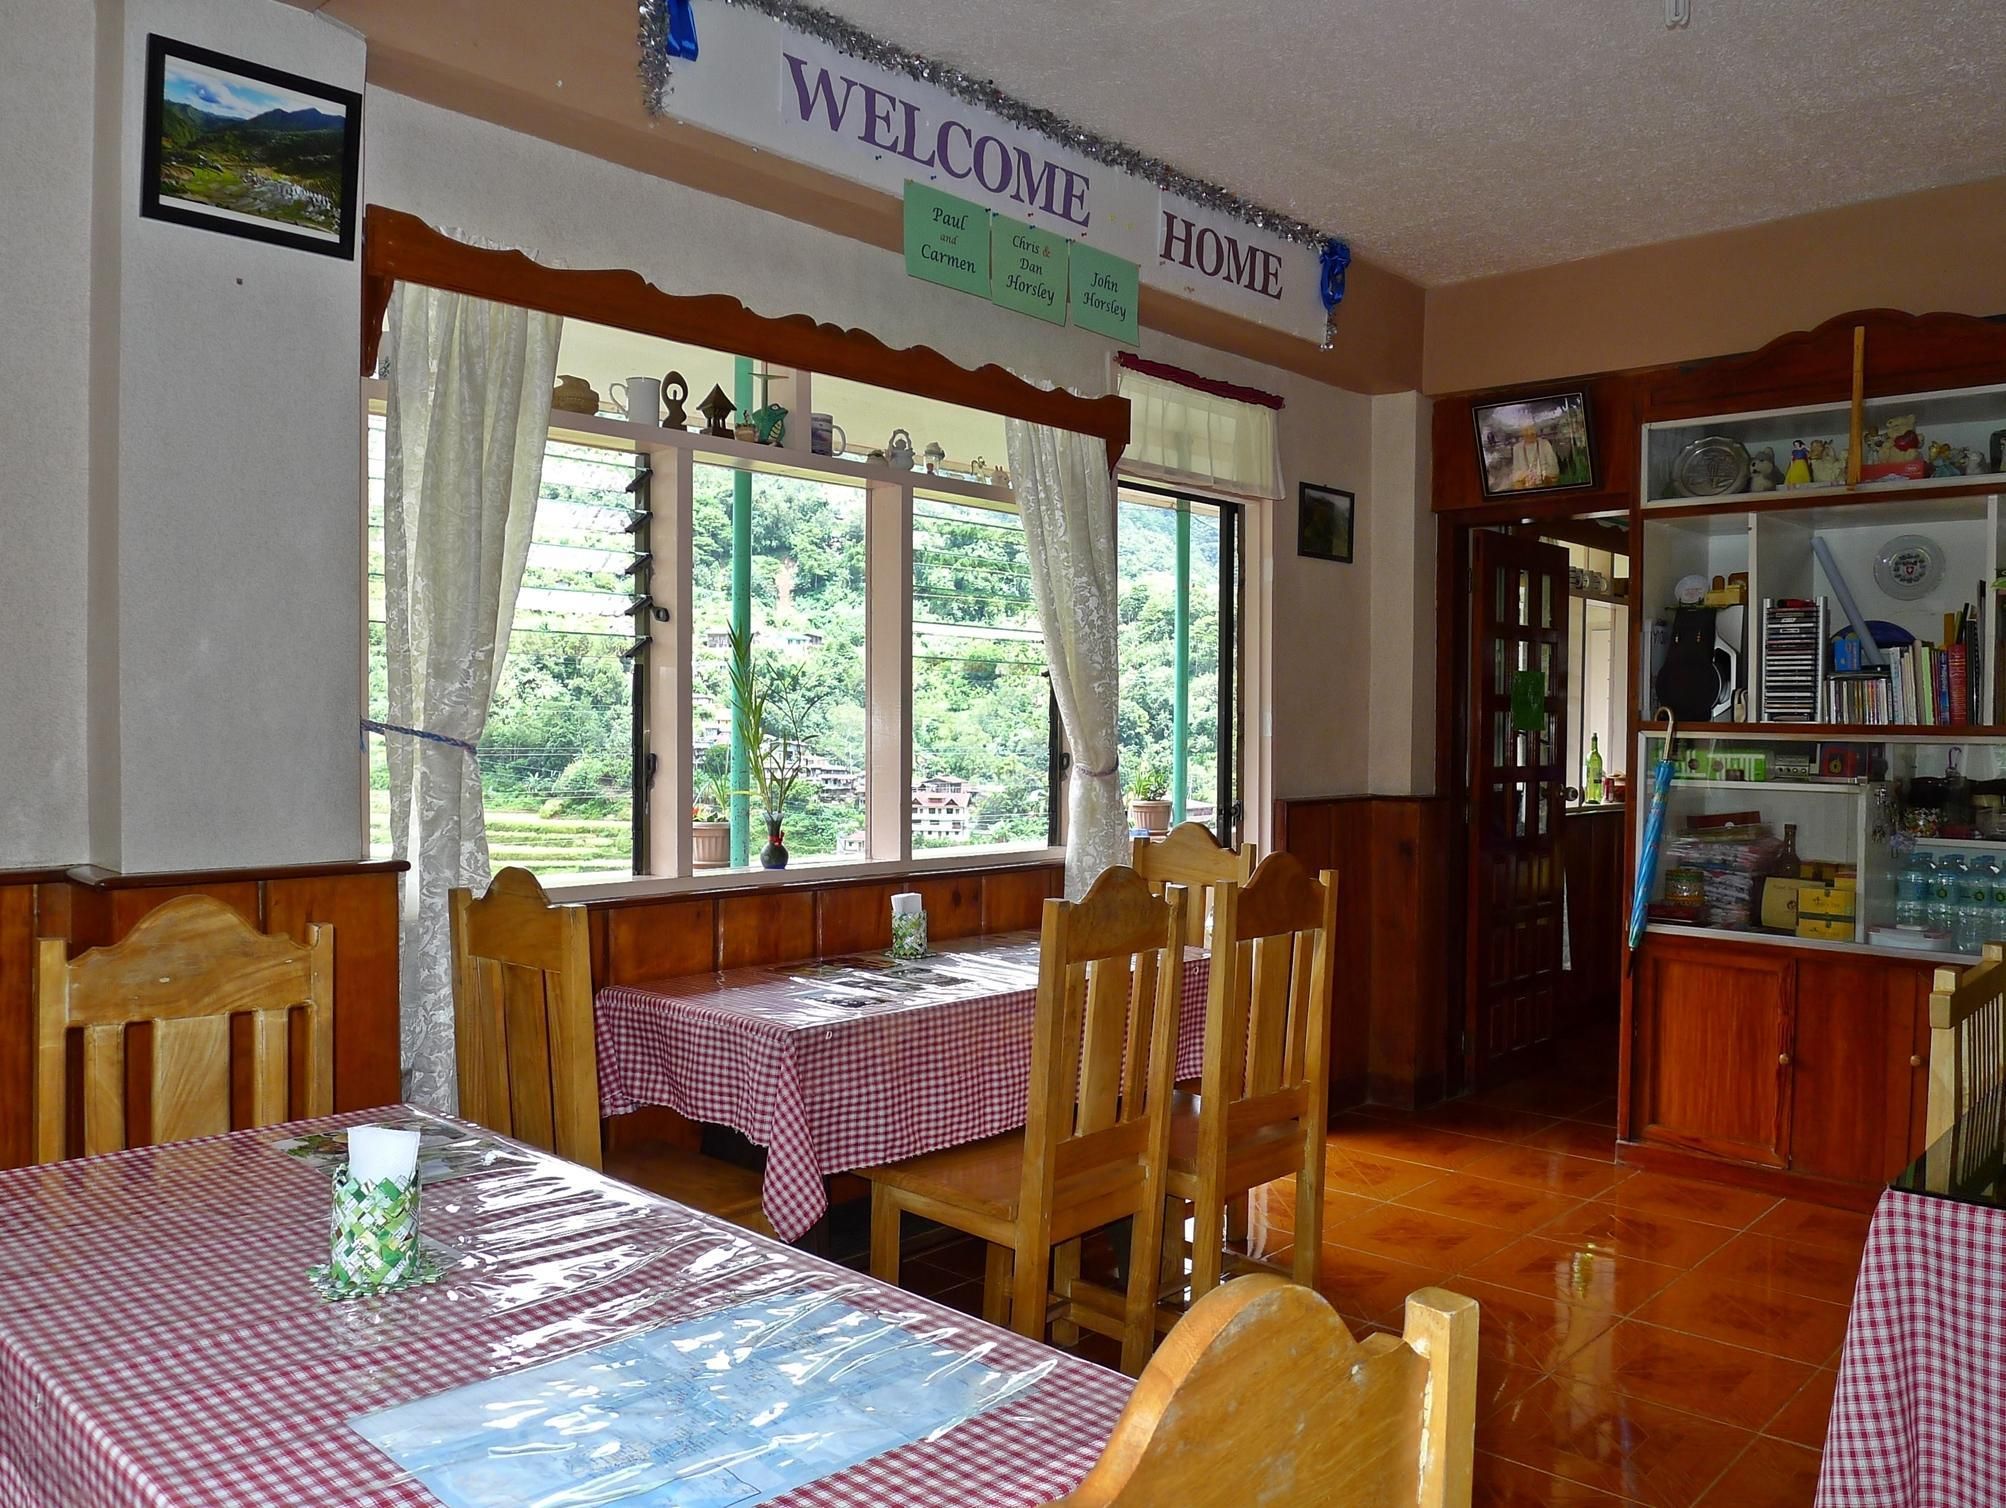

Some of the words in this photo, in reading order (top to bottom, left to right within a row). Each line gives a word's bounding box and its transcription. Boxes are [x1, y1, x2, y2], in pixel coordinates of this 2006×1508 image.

[783, 52, 1090, 227] WELCOME
[1159, 210, 1284, 300] HOME
[932, 207, 968, 230] Paul
[940, 234, 958, 246] and
[1012, 235, 1040, 254] Chris
[1042, 246, 1051, 258] &
[921, 244, 976, 273] Carmen
[1019, 258, 1042, 275] Dan
[1006, 275, 1055, 306] Horsley
[1090, 272, 1118, 292] John
[1082, 292, 1127, 321] Horsley
